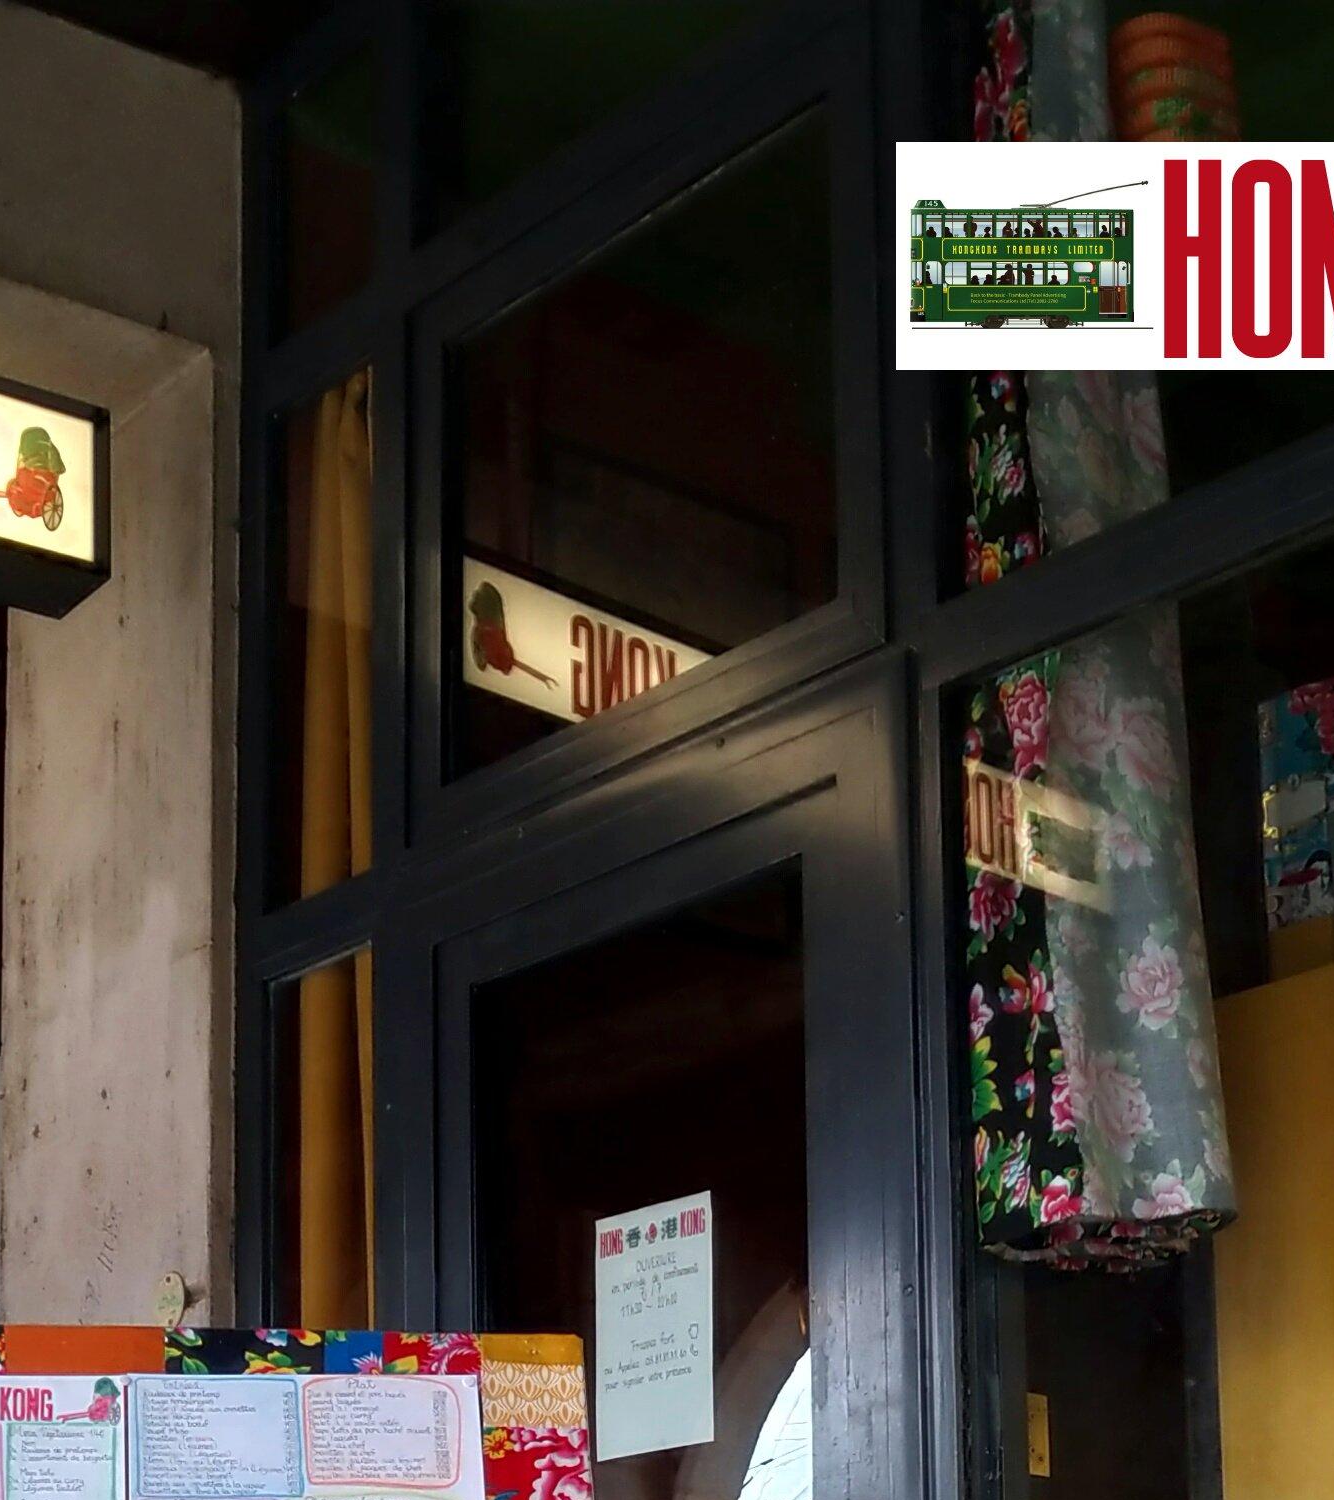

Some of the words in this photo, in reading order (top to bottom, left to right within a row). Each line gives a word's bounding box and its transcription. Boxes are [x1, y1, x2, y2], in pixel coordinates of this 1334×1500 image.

[600, 1228, 623, 1259] HONG
[626, 1226, 641, 1248] 香
[661, 1217, 677, 1240] 港
[680, 1207, 705, 1238] KONG
[0, 1386, 54, 1421] KONG
